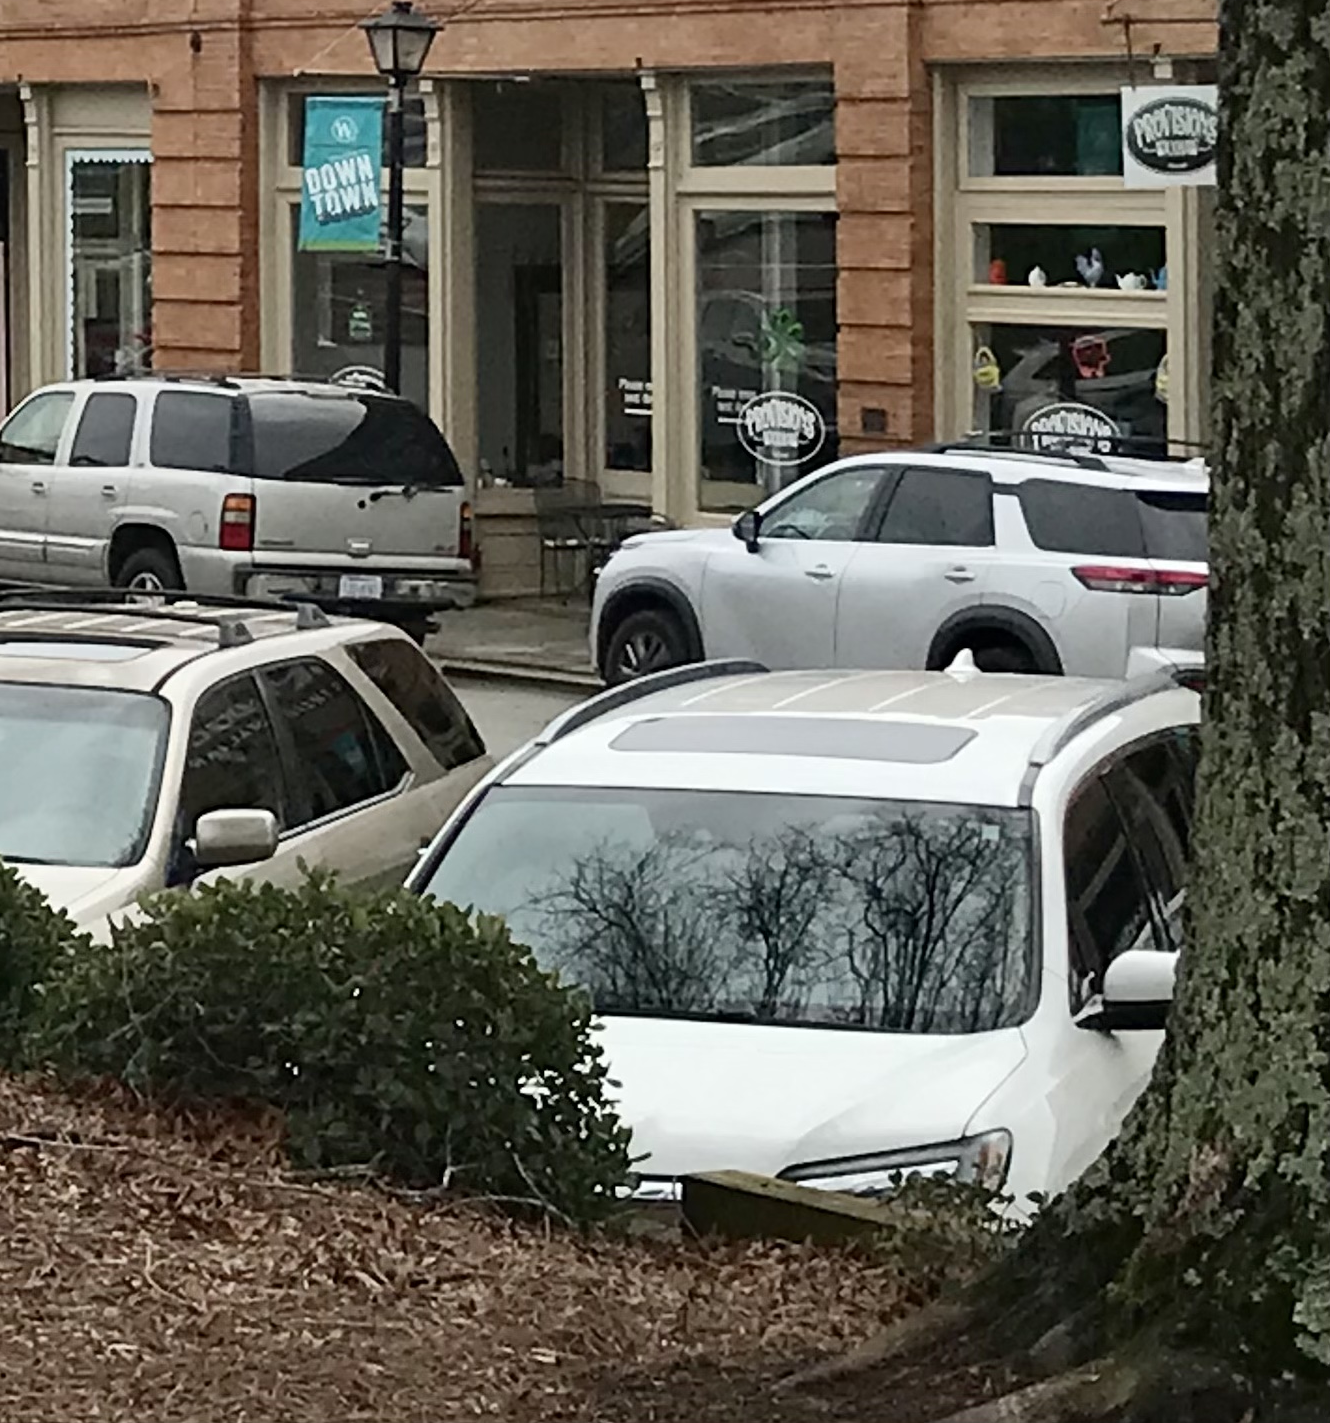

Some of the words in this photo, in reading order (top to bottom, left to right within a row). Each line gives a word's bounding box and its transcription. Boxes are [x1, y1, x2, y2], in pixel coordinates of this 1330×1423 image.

[1133, 104, 1218, 148] PROVISIONS
[305, 154, 374, 195] DOWN
[310, 181, 379, 217] TOWN
[745, 399, 815, 440] PROVISIONS
